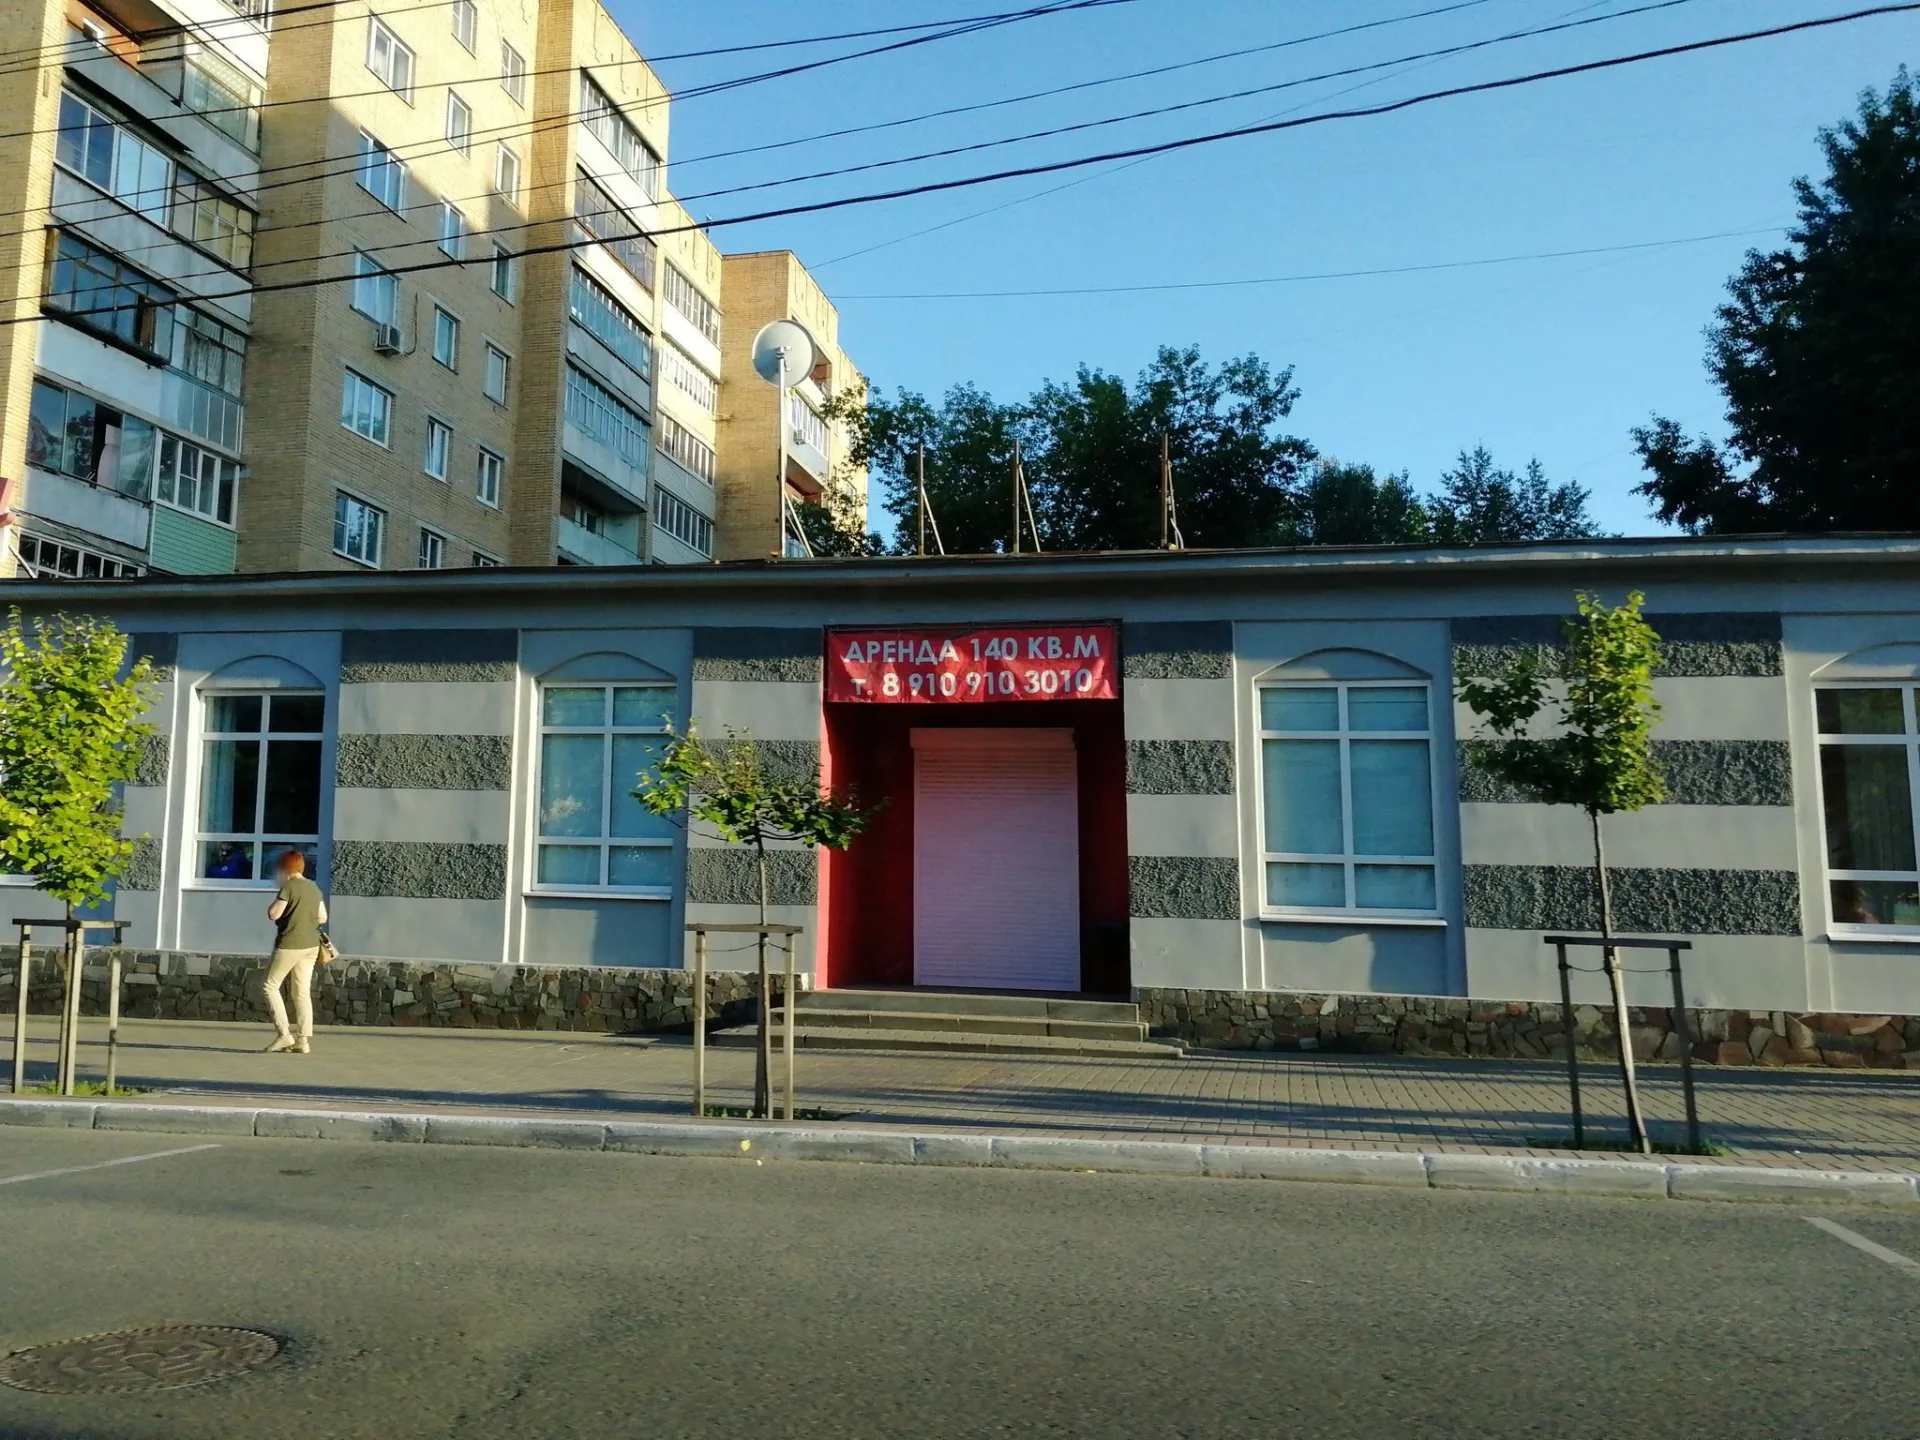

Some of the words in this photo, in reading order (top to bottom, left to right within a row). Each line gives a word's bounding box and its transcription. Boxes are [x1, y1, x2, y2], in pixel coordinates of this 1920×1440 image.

[844, 640, 960, 666] АРЕНДА
[970, 637, 1018, 661] 140
[1027, 634, 1101, 660] КВ.М
[851, 678, 874, 696] т.
[882, 674, 900, 697] 8
[908, 672, 957, 697] 910
[965, 671, 1016, 696] 910
[1023, 668, 1093, 693] 3010
